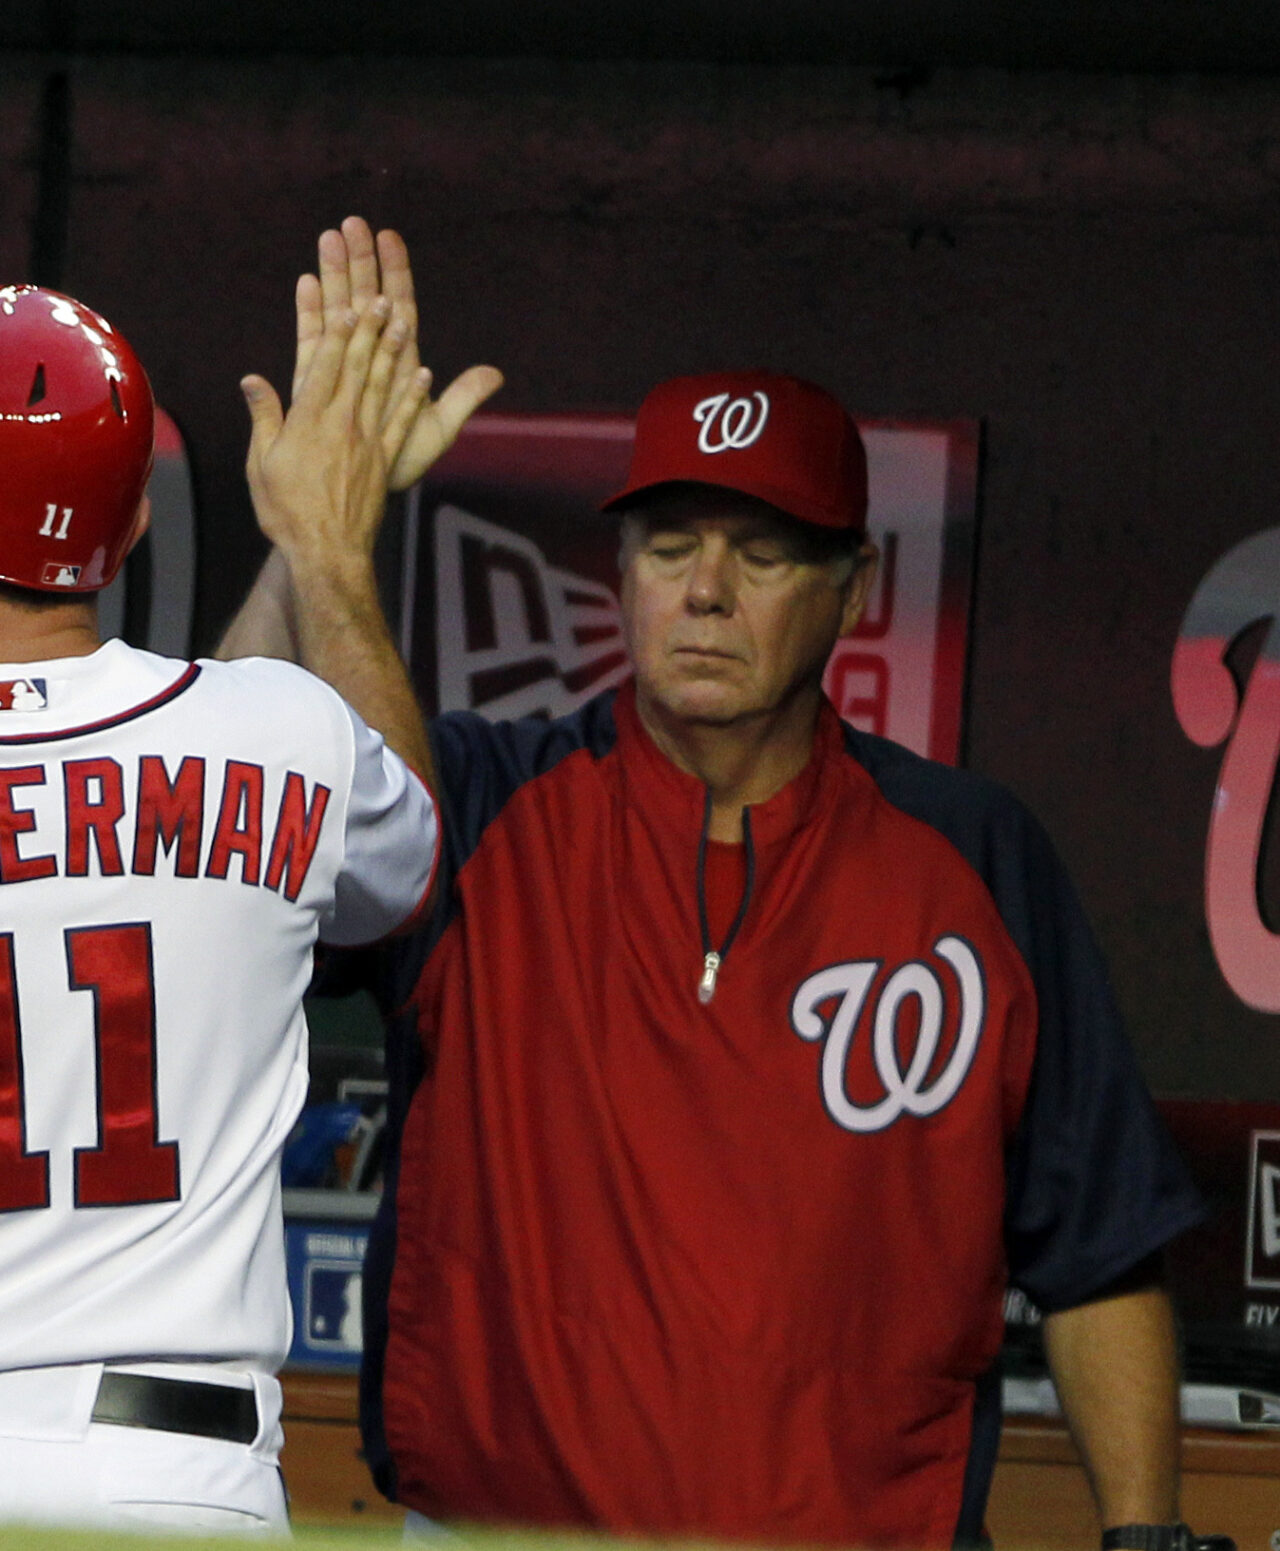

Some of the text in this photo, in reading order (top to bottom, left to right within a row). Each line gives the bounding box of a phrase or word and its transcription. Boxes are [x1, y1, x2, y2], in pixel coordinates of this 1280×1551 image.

[693, 391, 770, 455] W
[38, 503, 74, 540] 11
[790, 931, 987, 1135] W
